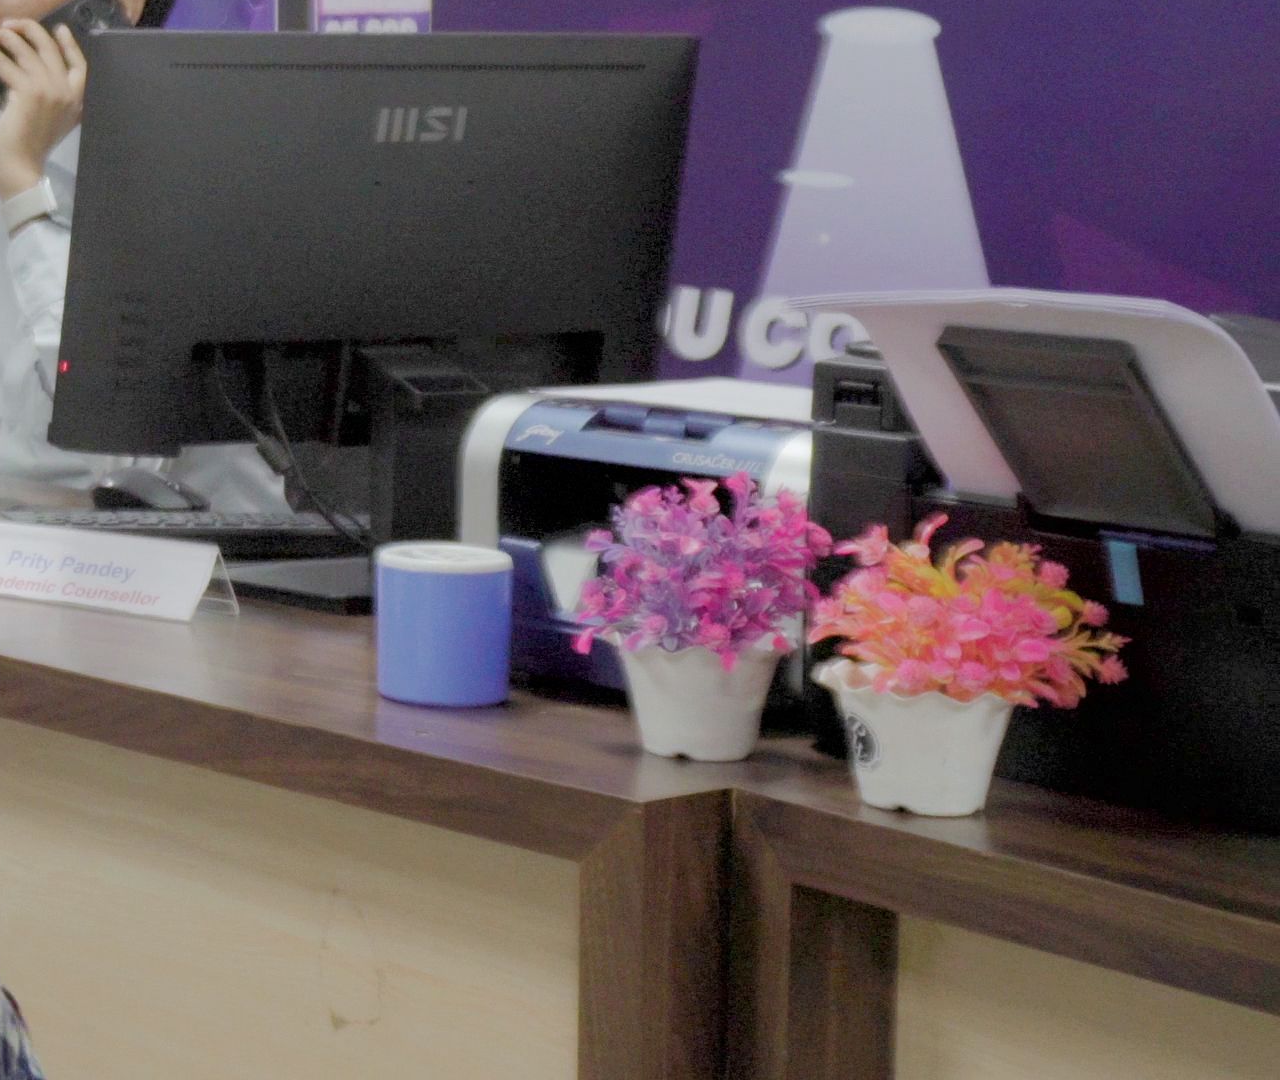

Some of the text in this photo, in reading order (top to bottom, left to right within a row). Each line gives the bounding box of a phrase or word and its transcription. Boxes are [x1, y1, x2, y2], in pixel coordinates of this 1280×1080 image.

[5, 549, 137, 585] Prity Pandey
[60, 580, 161, 607] Counsellor
